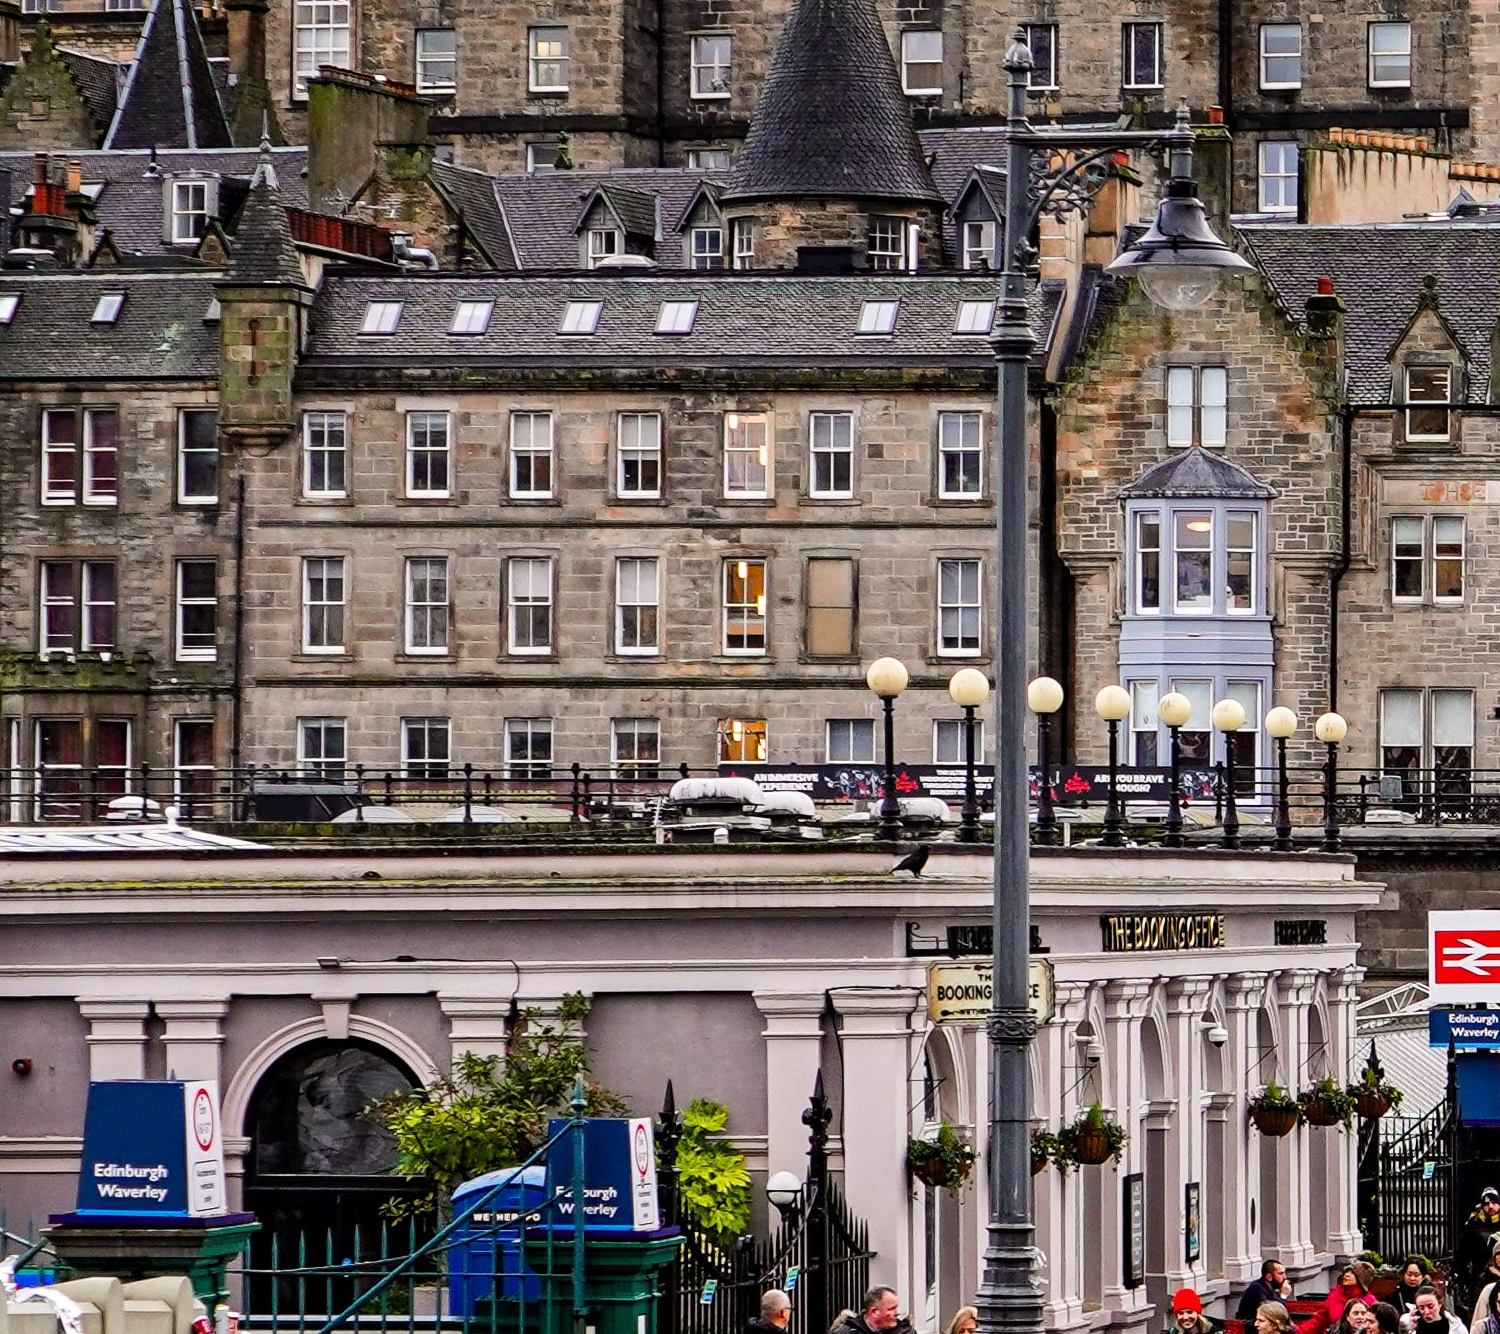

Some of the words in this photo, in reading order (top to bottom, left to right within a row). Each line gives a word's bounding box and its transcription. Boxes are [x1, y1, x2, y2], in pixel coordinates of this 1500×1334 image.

[1108, 916, 1132, 950] THE
[1134, 916, 1186, 949] BOOKING
[1187, 915, 1225, 947] OFFICE
[978, 974, 992, 982] TH
[937, 985, 992, 1001] BOOKING
[1449, 1013, 1499, 1026] Edinburgh
[1451, 1027, 1499, 1039] Waverley
[94, 1163, 169, 1182] Edinburgh
[97, 1184, 169, 1202] Waverley
